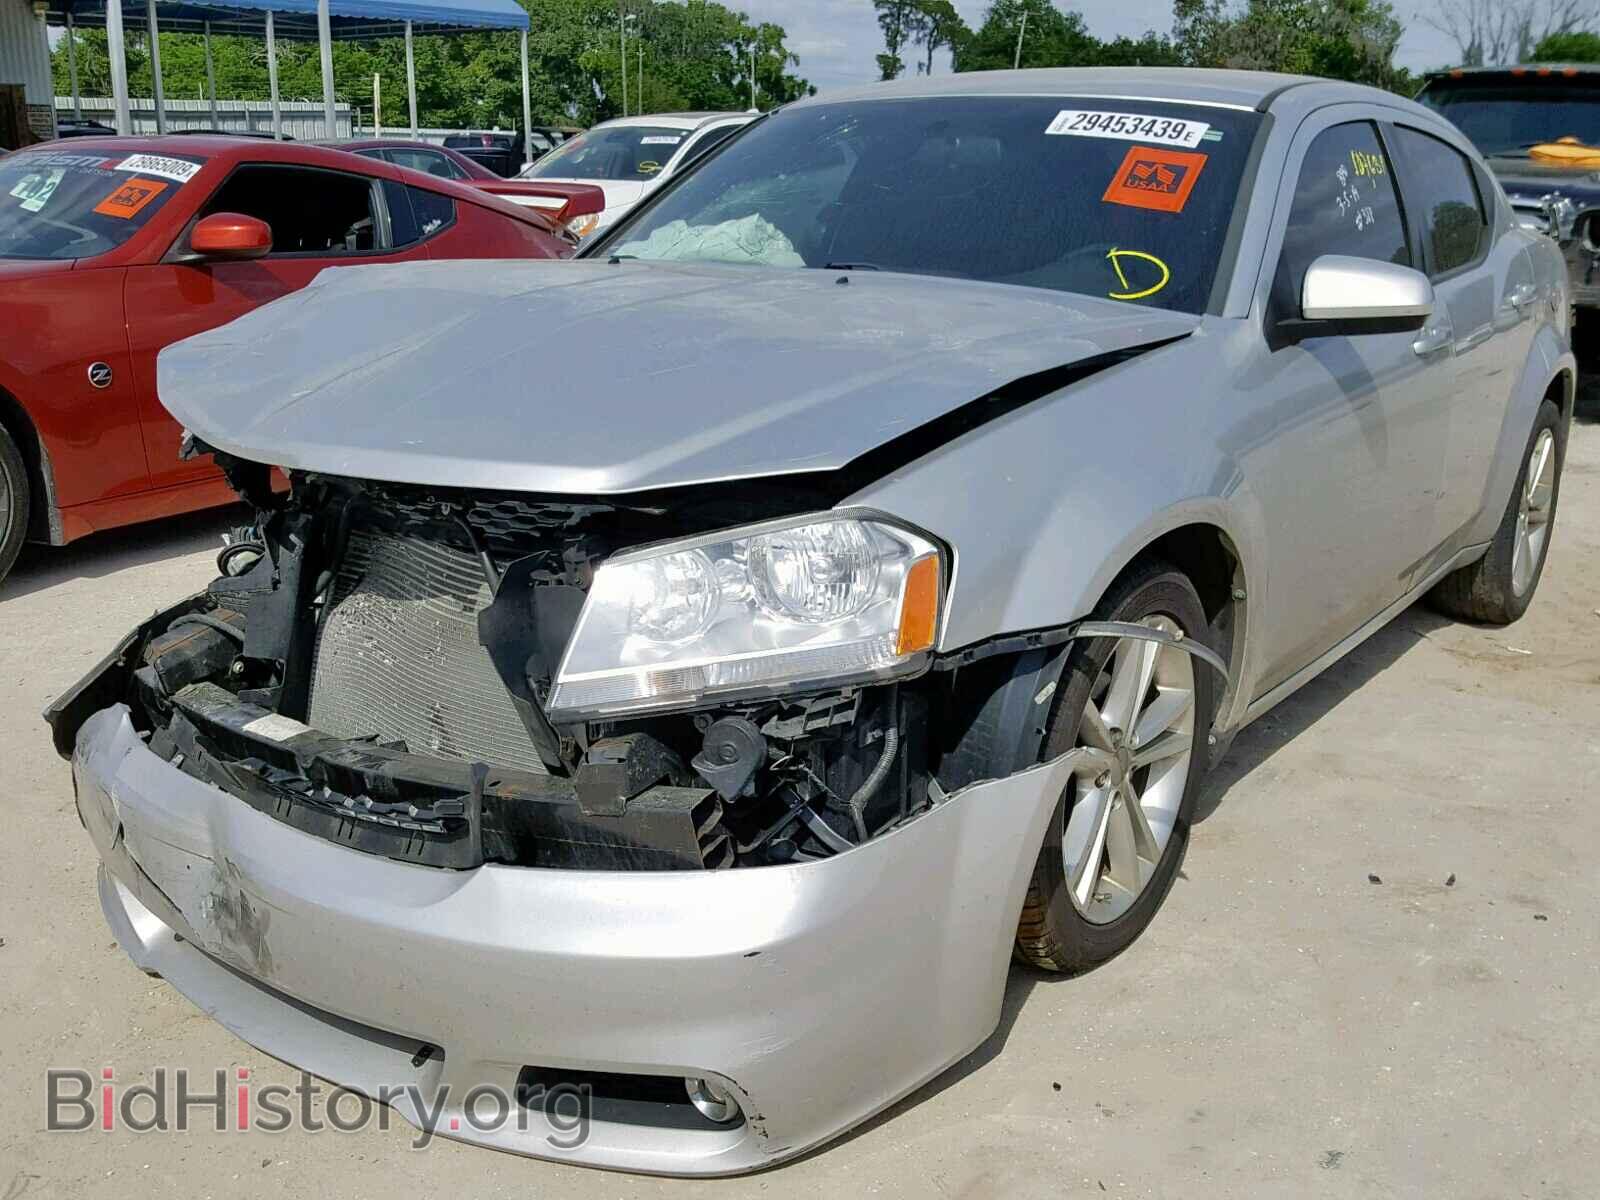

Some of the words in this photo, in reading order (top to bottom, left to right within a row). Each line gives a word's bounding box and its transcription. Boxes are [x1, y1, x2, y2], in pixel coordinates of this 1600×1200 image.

[1067, 113, 1187, 139] 29453439
[1126, 178, 1169, 192] USAA
[1105, 247, 1169, 299] D
[93, 368, 112, 381] Z
